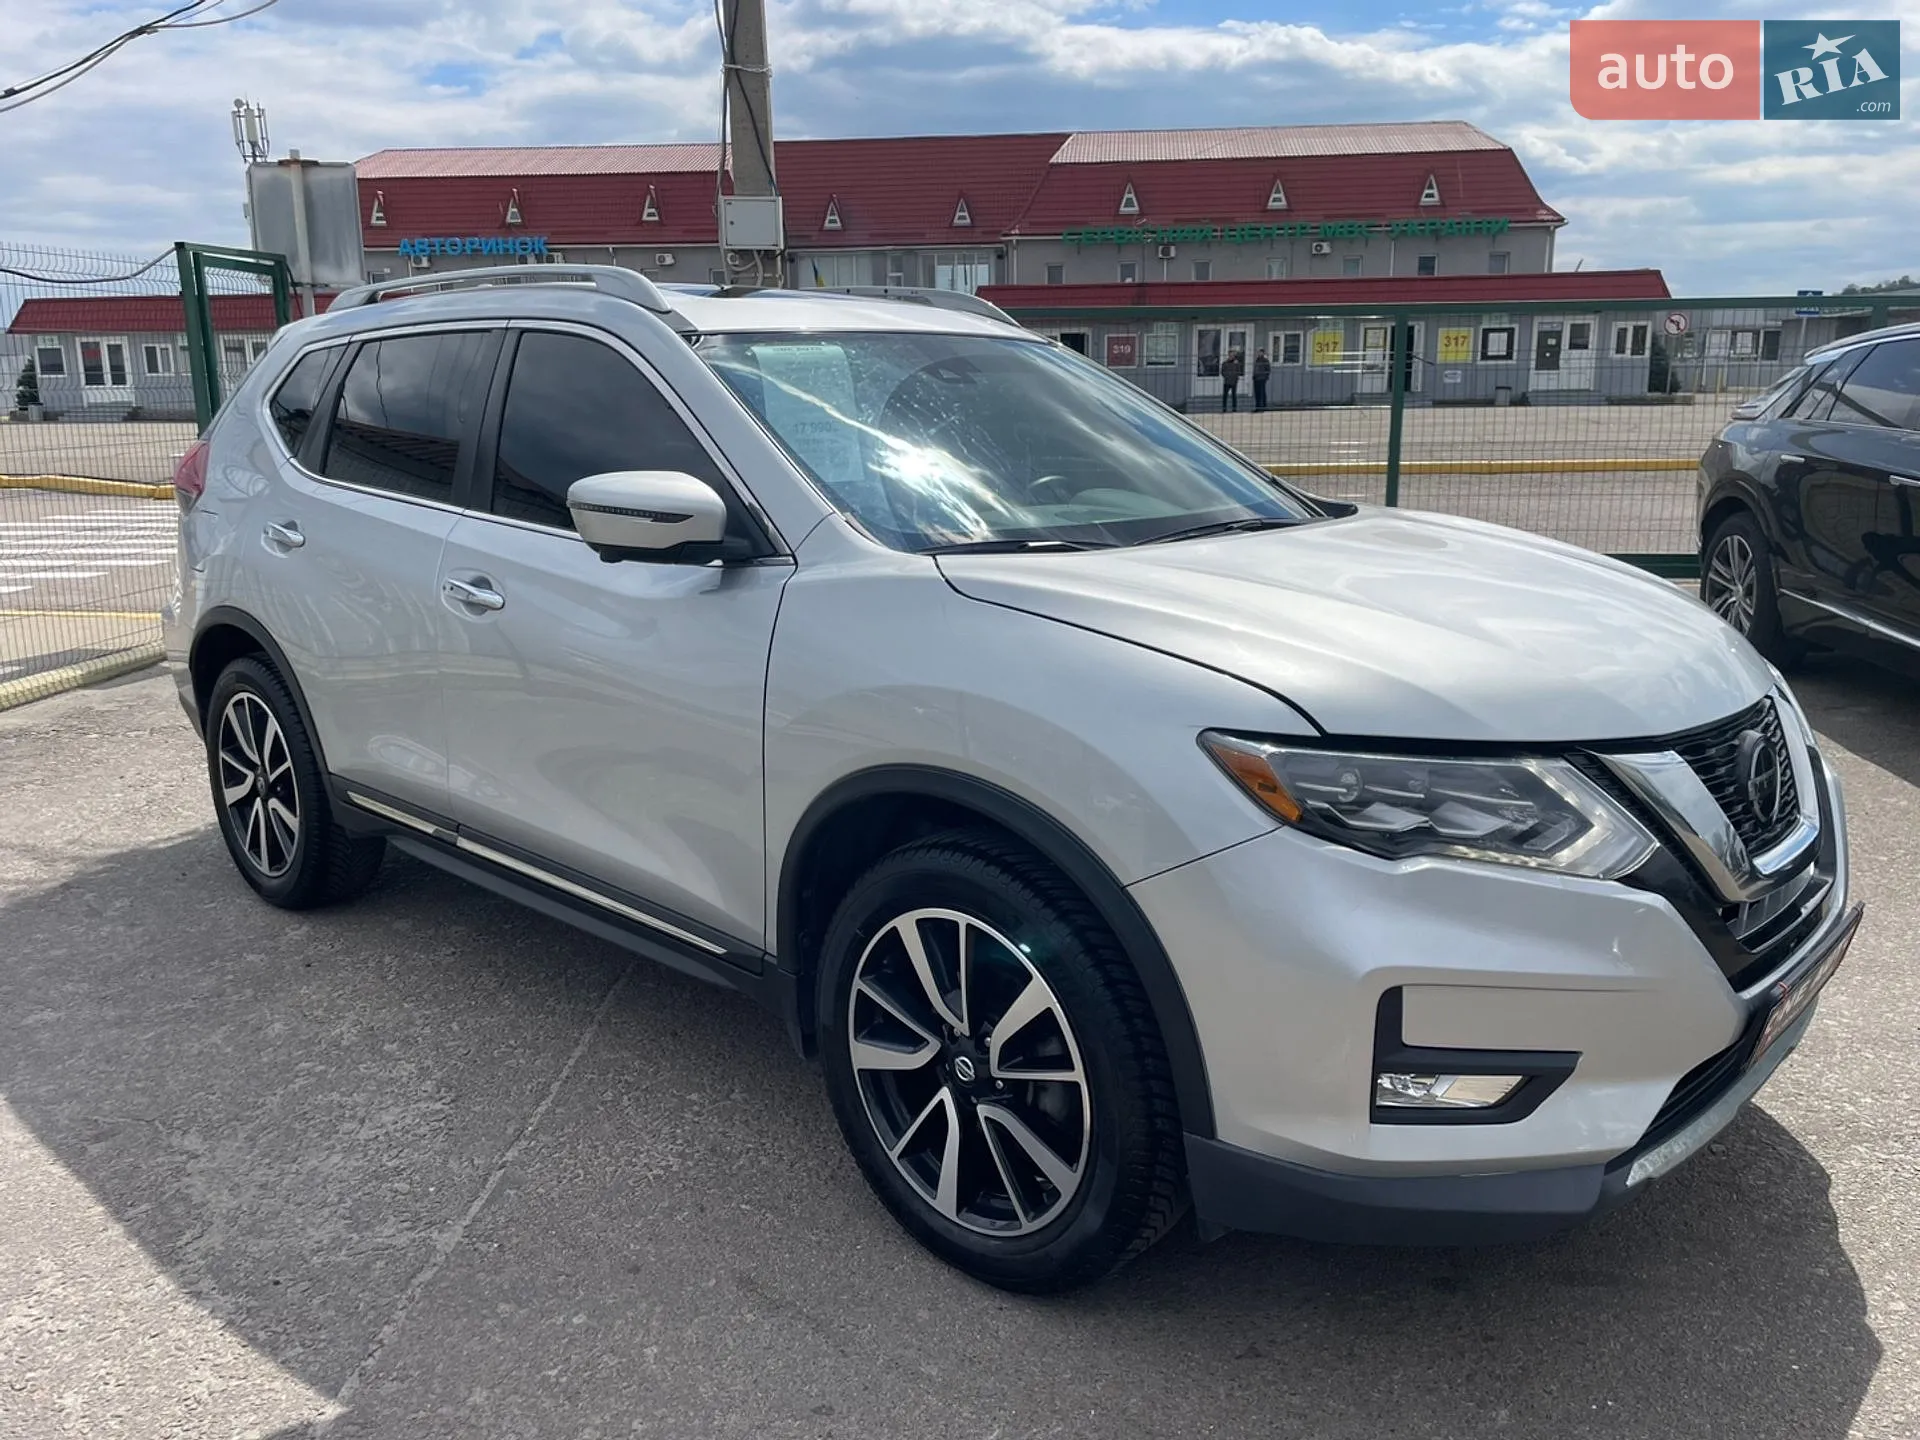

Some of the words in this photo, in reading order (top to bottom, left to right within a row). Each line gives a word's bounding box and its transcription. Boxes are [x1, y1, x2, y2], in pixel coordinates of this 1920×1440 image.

[1223, 222, 1314, 242] ЦЕНТР
[398, 236, 549, 256] АВТОРИНОК
[1315, 341, 1339, 353] 317
[1443, 335, 1468, 347] 317
[1112, 344, 1131, 353] 319
